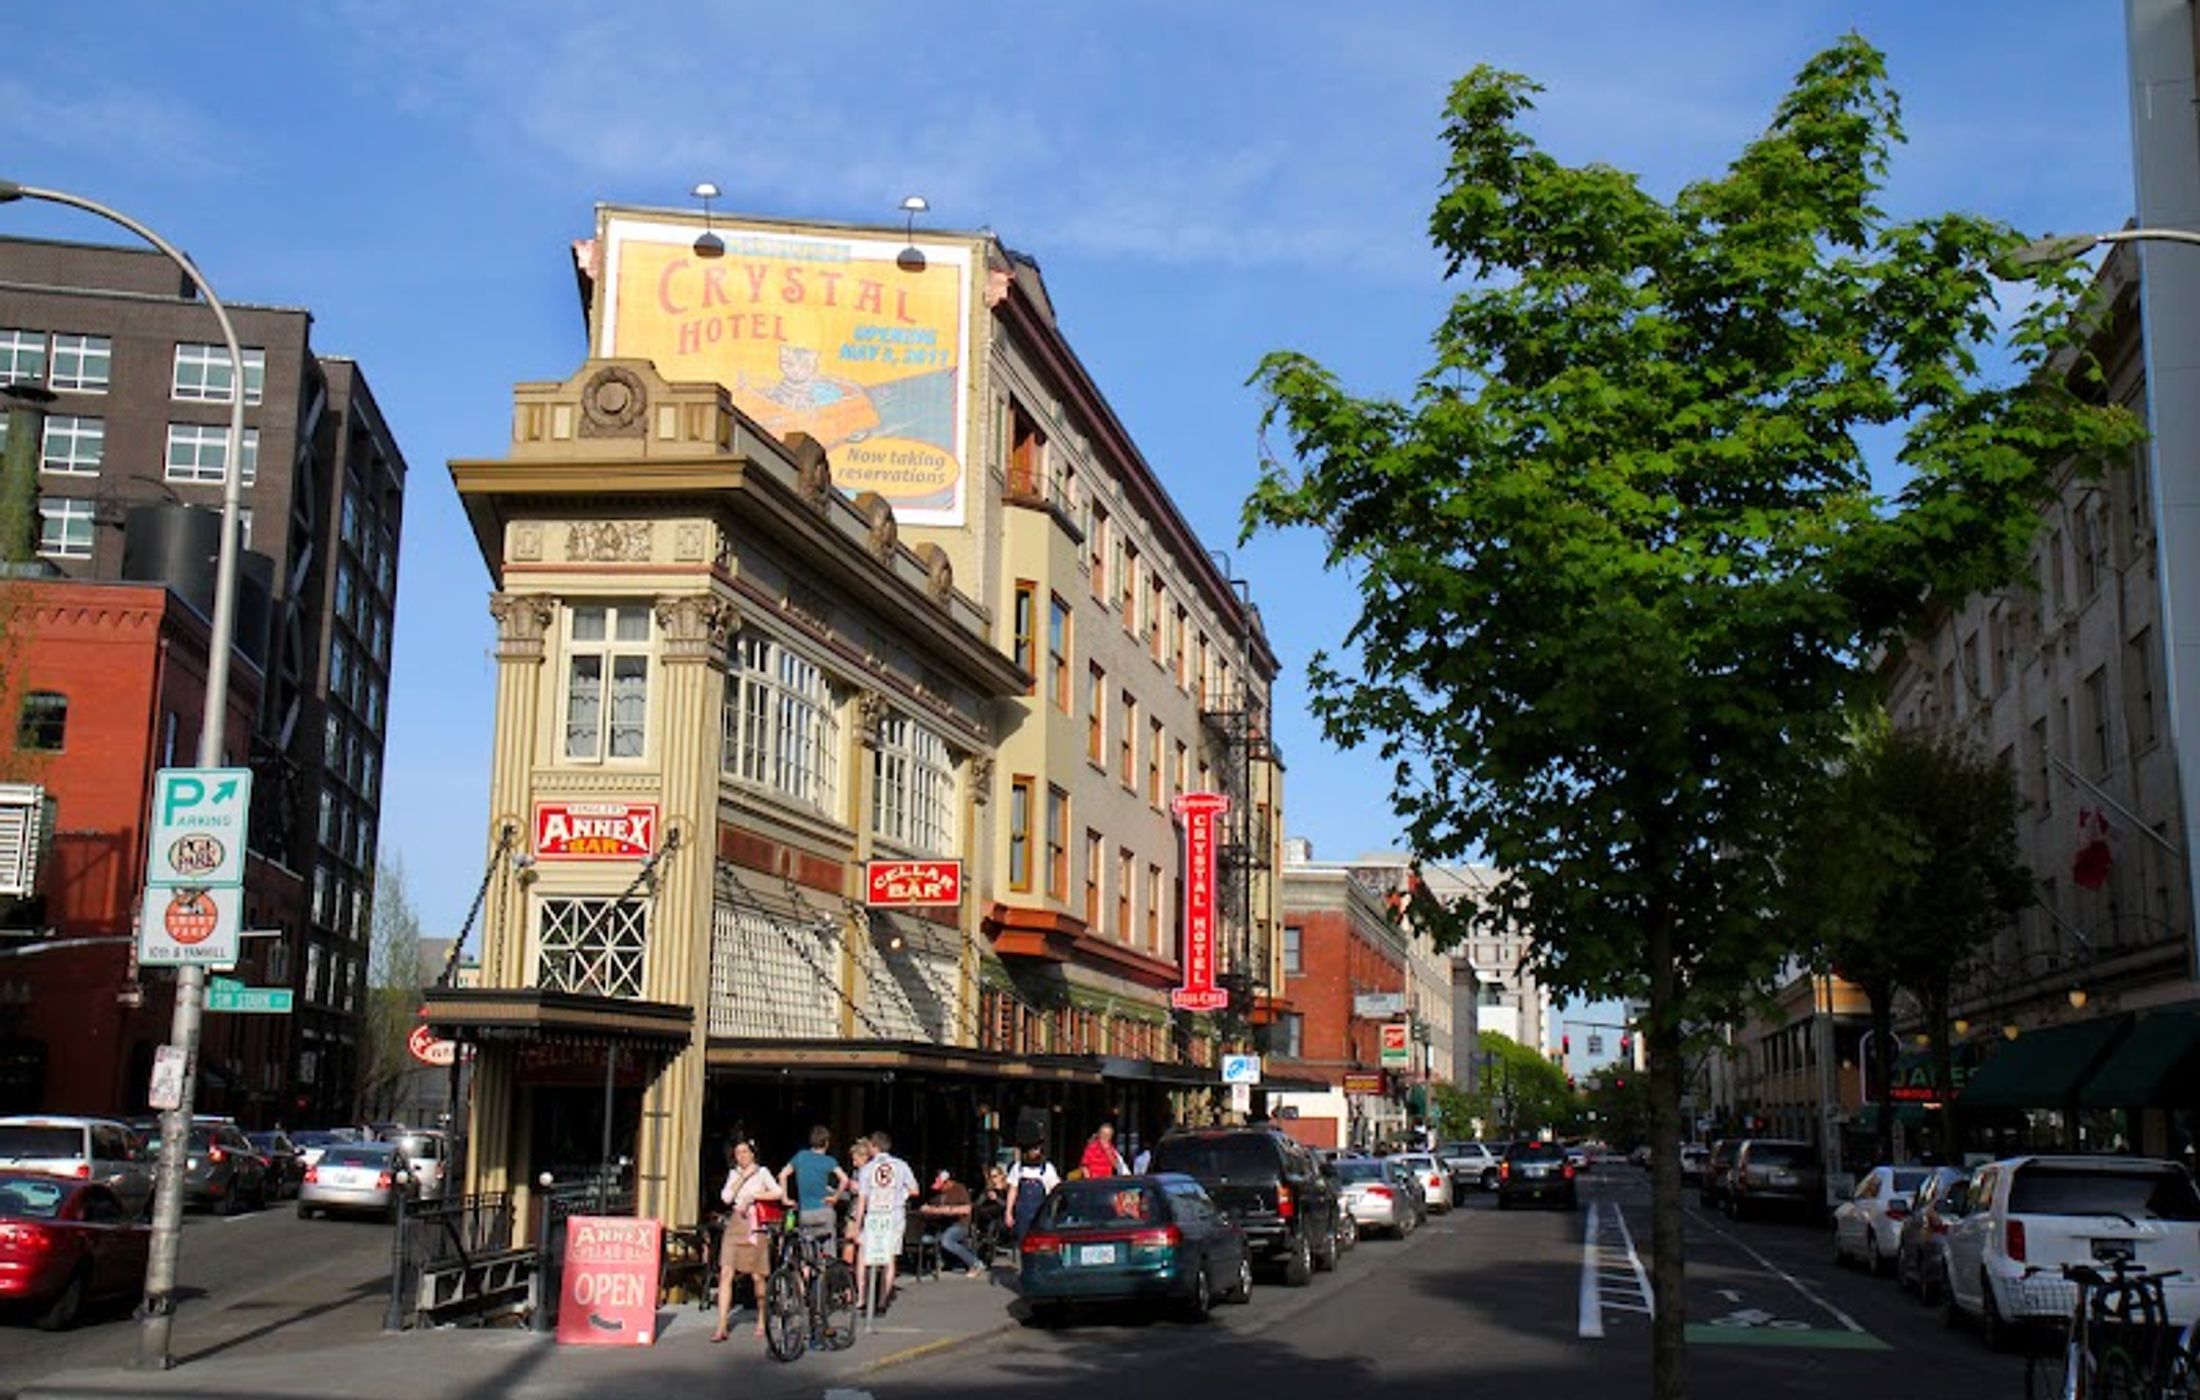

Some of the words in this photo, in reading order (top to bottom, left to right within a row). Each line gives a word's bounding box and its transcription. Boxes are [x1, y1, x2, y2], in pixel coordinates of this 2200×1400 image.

[658, 259, 916, 324] CRYSTAL
[678, 312, 788, 355] HOTEL
[847, 447, 887, 463] Now
[890, 449, 946, 472] taking
[838, 466, 946, 485] reservations
[539, 813, 651, 852] ANNEX
[568, 837, 620, 854] BAR
[1193, 813, 1207, 907] CRYSTAL
[873, 864, 955, 891] CELLAR
[887, 883, 942, 899] BAR
[1193, 918, 1207, 984] HOTEL
[574, 1226, 651, 1249] ANNEX
[574, 1272, 646, 1307] OPEN
